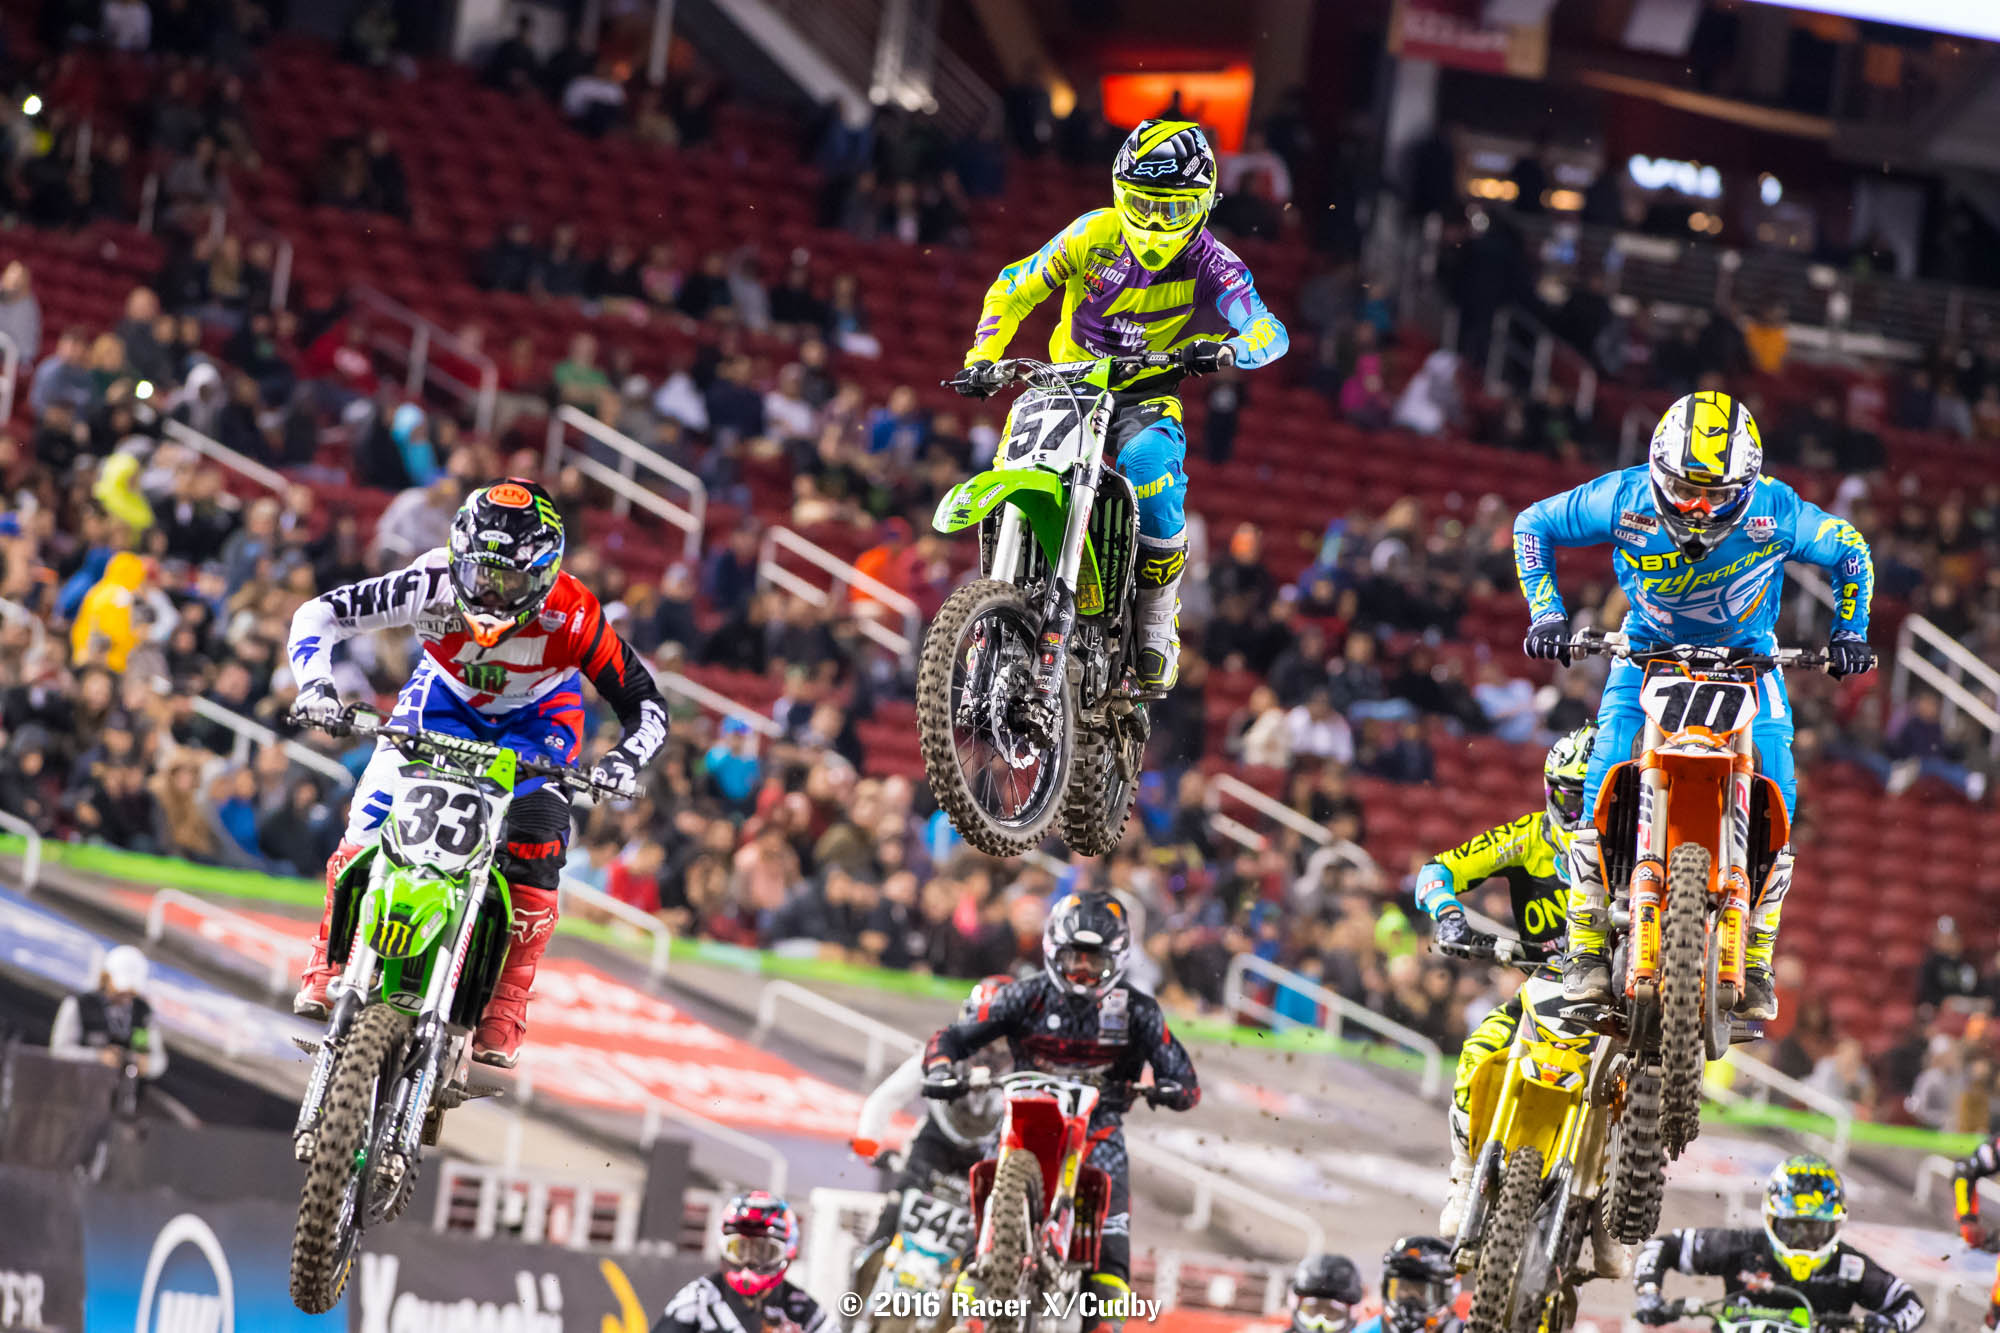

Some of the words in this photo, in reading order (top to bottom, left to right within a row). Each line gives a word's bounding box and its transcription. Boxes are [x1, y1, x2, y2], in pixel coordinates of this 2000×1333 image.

[1112, 316, 1146, 337] Nut
[1121, 334, 1146, 352] Up
[1006, 398, 1094, 462] 57
[320, 567, 448, 618] SHIFT
[1642, 566, 1695, 596] FLY
[1686, 538, 1785, 594] RACING
[1654, 681, 1747, 734] 10
[399, 785, 493, 855] 33
[406, 1068, 424, 1119] CARRILLO
